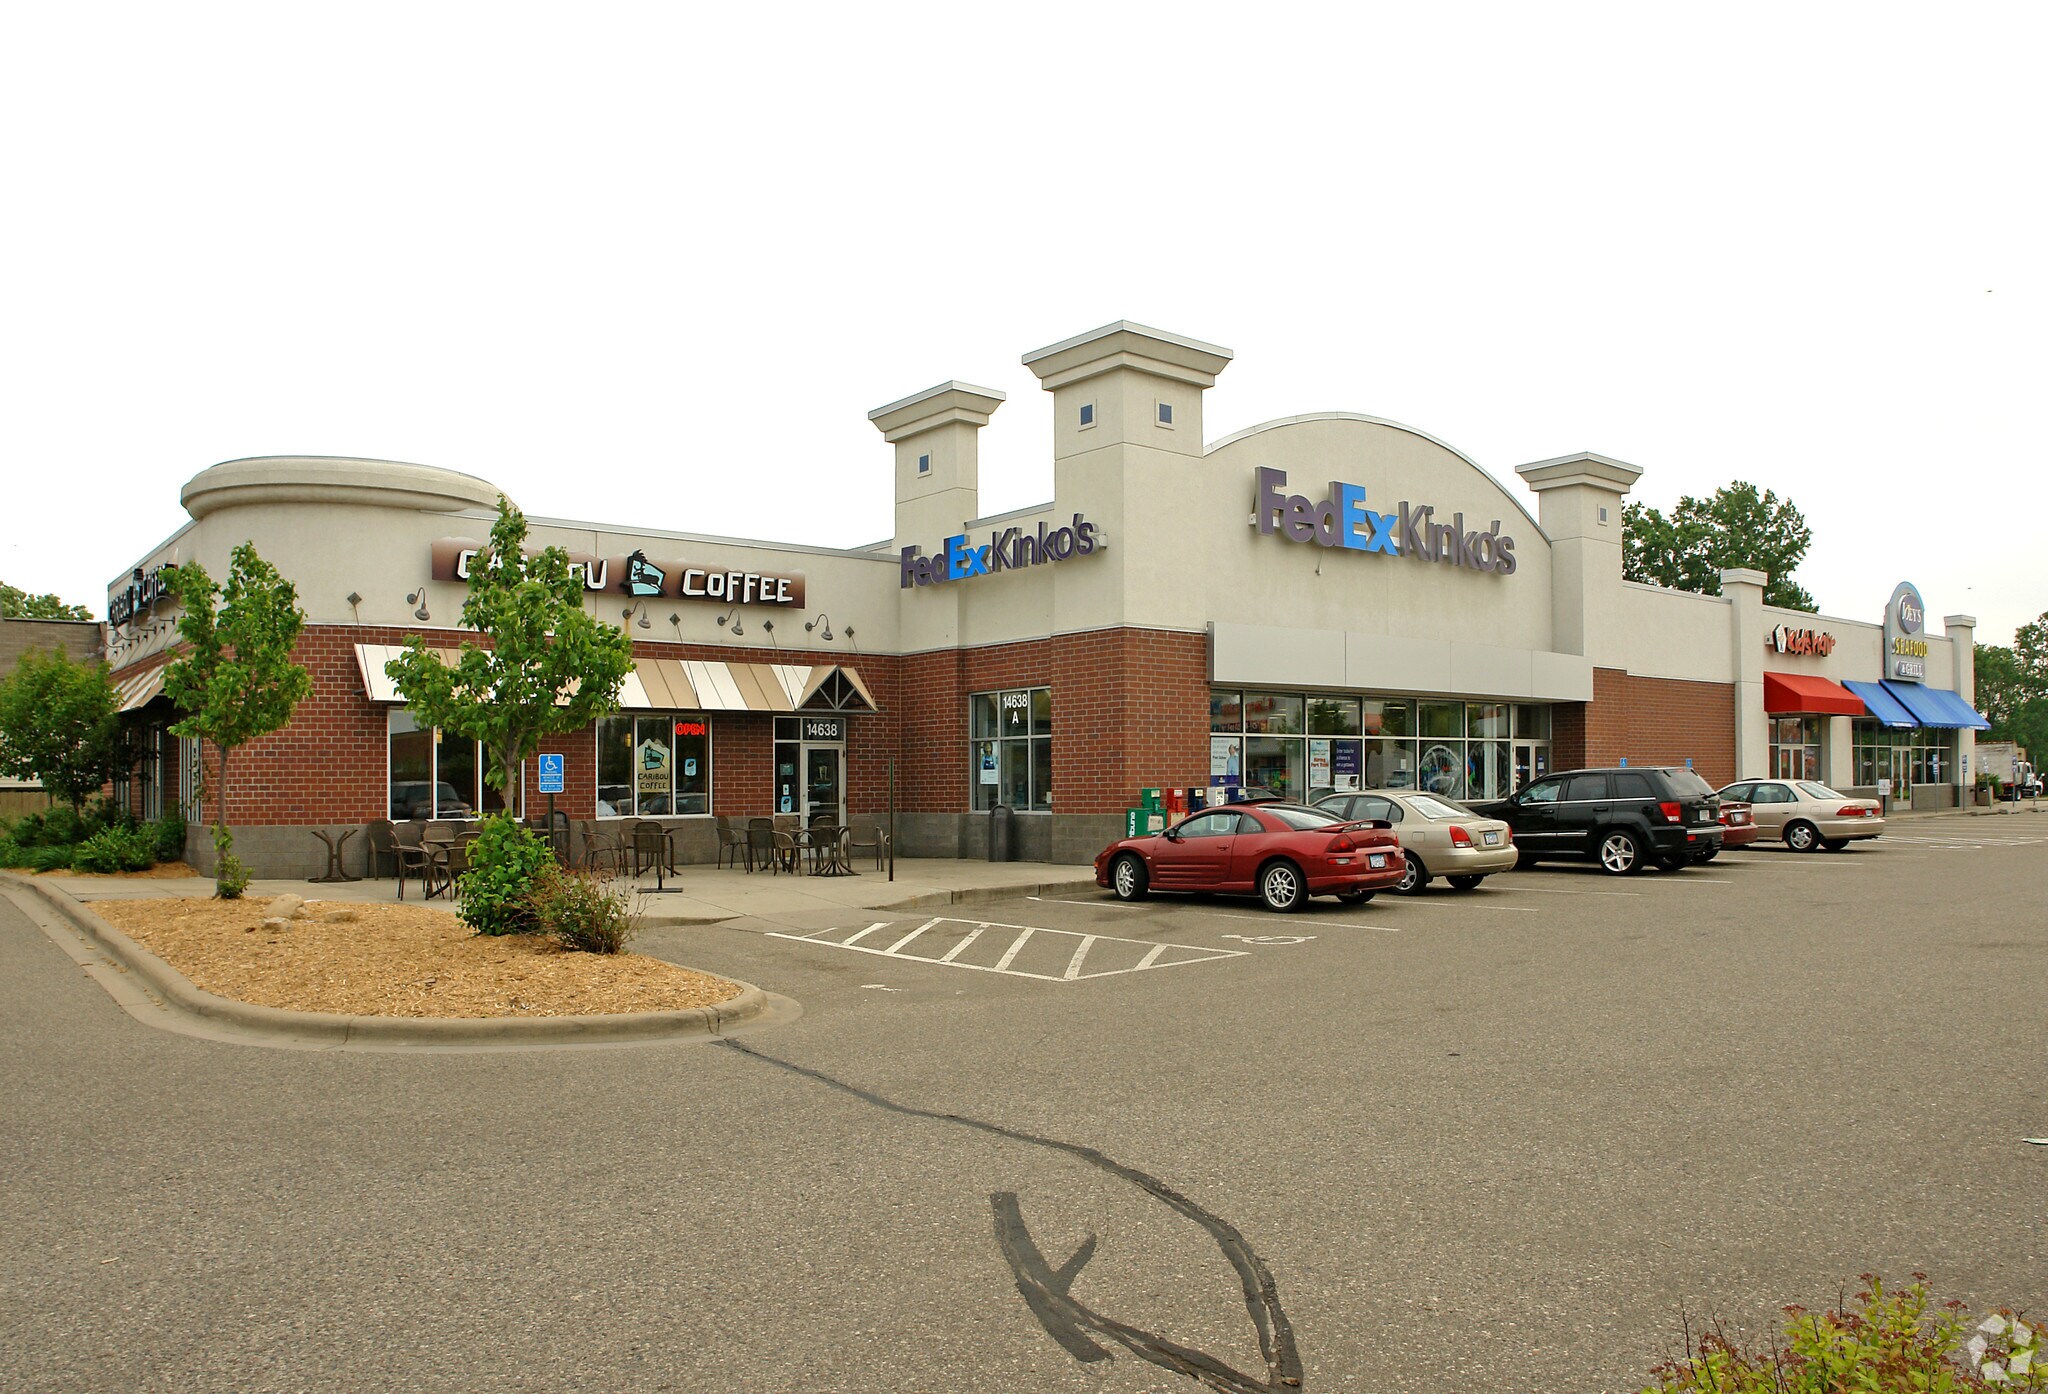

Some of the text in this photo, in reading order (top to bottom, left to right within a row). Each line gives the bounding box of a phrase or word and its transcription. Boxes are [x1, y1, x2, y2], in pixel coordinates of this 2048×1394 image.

[1254, 466, 1517, 575] FedEx Kinko's
[901, 513, 1100, 588] FedEx Kinko's
[682, 568, 793, 603] COFFEE
[1895, 637, 1929, 657] SEAFOOD
[1003, 693, 1028, 709] 14638
[1012, 711, 1019, 724] A
[675, 722, 706, 736] OPEN
[806, 723, 838, 737] 14638
[638, 772, 668, 780] CARIBOU
[640, 782, 666, 790] COFFEE
